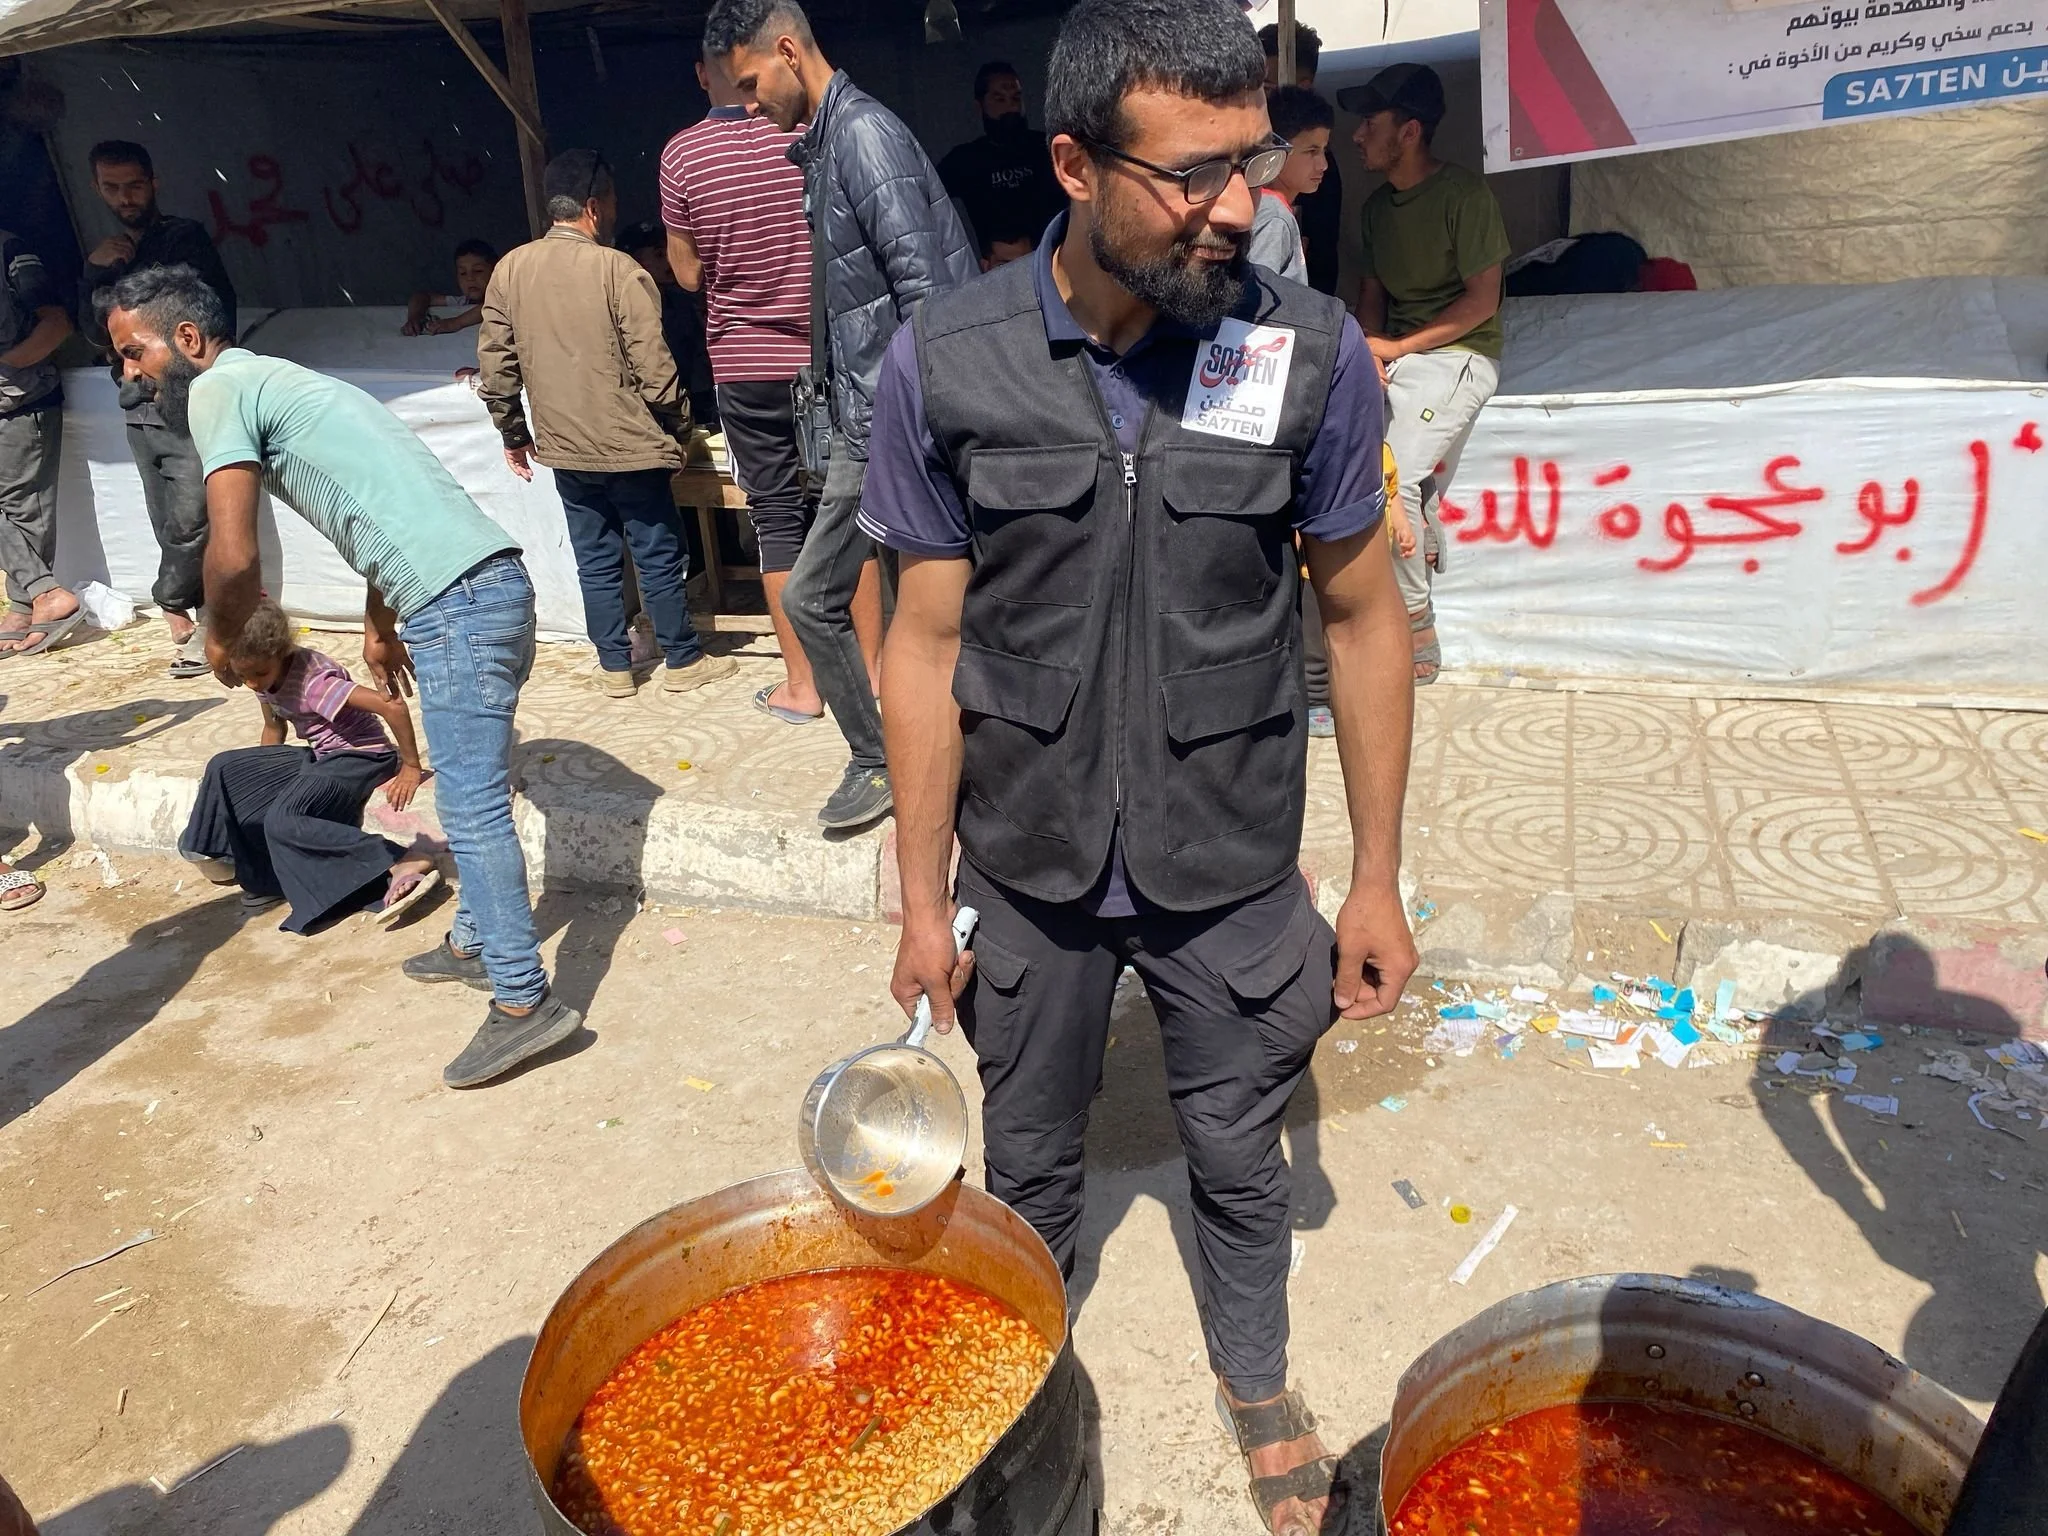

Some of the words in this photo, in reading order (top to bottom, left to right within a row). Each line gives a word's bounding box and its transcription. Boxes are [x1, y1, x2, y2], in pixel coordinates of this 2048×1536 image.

[1786, 5, 1859, 36] بيوتهم
[1987, 21, 2033, 41] بدعم
[1867, 31, 1926, 58] وكريم
[1932, 26, 1982, 52] سخي
[1776, 43, 1829, 69] الأخوة
[1834, 43, 1862, 62] من
[1739, 54, 1771, 79] في
[1846, 63, 1987, 106] SA7TEN
[991, 165, 1034, 184] BOSS
[1200, 395, 1266, 417] صحتين
[1196, 413, 1263, 436] SA7TEN
[1594, 455, 1824, 573] عجوة
